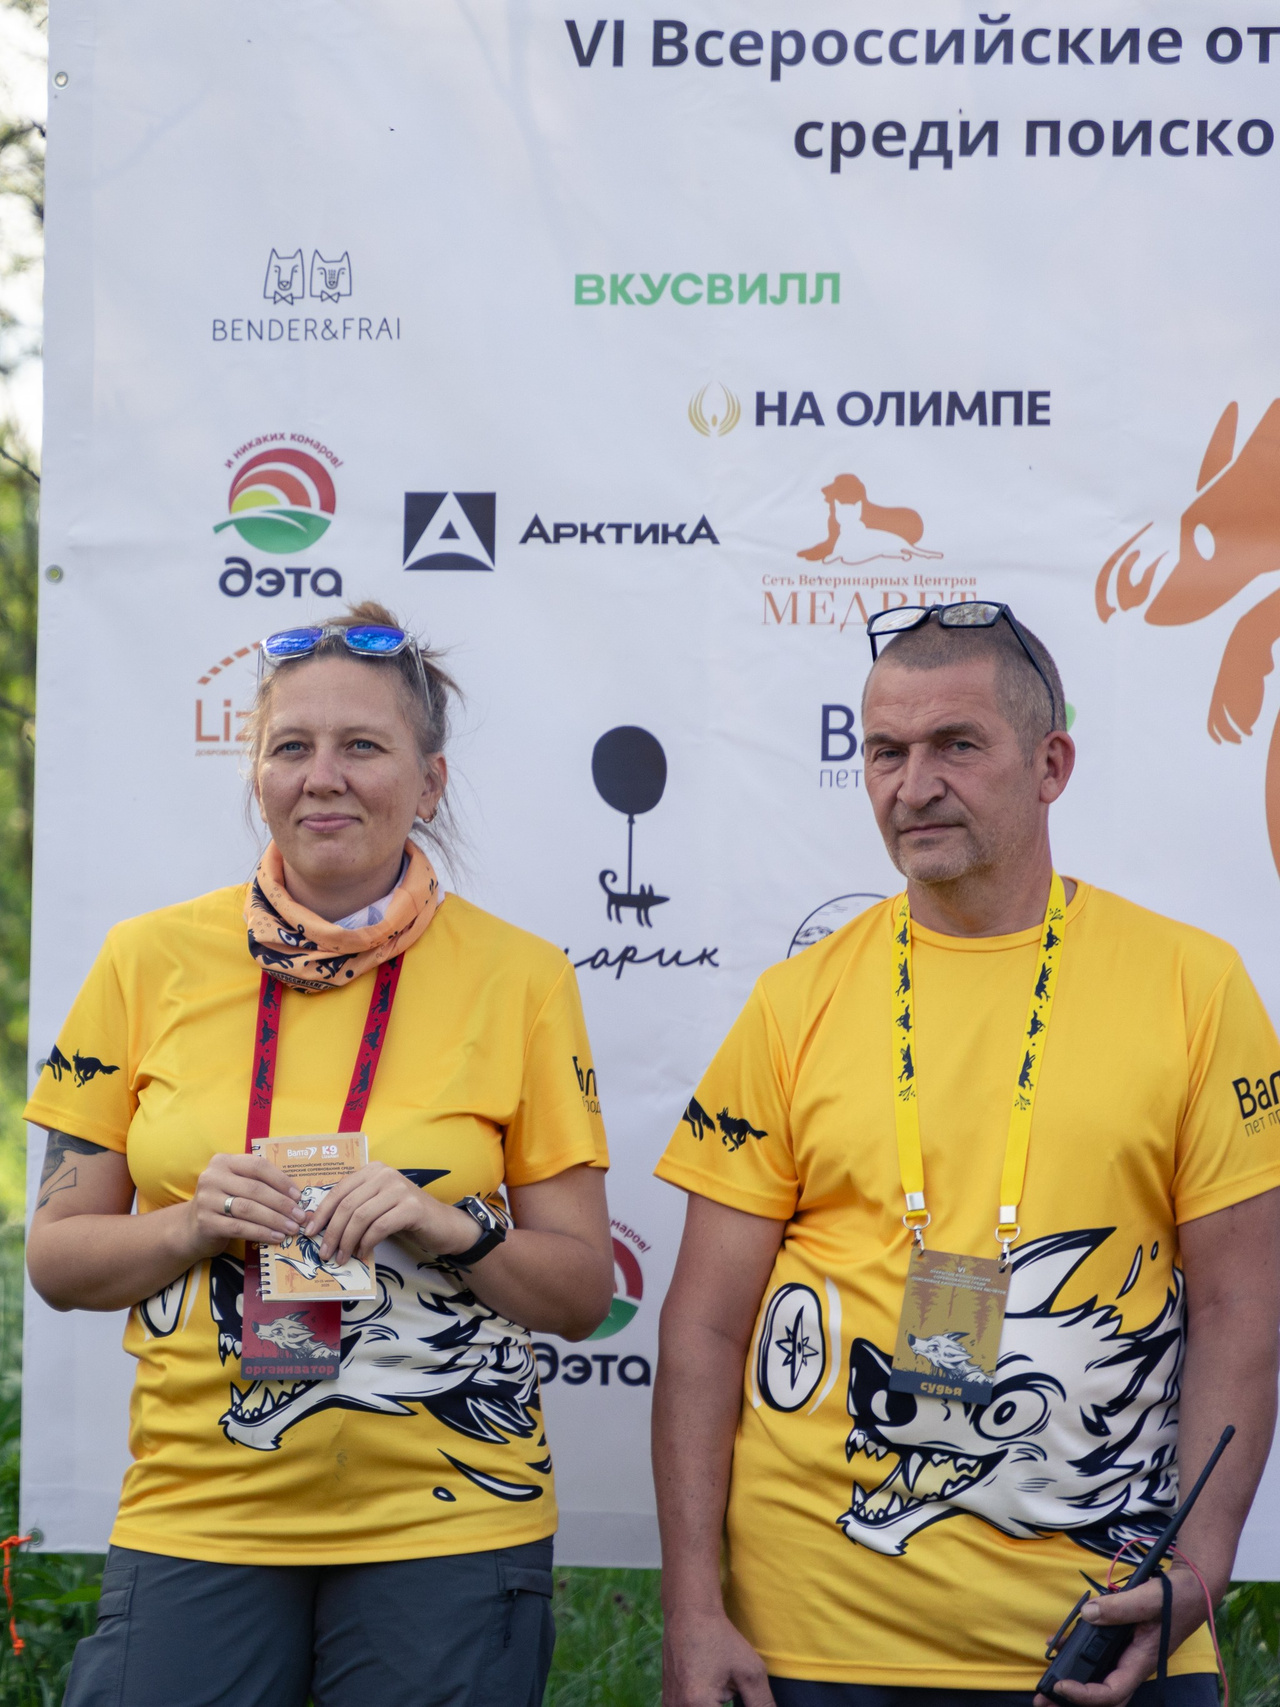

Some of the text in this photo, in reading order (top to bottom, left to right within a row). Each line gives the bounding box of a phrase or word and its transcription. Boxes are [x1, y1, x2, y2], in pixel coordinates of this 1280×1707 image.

[565, 19, 624, 68] VI
[651, 13, 1184, 82] Всероссийские
[793, 116, 1276, 174] среди поиско
[574, 272, 841, 306] ВКУСВИЛЛ
[211, 317, 401, 342] BENDER&FRAI
[755, 390, 1051, 427] НА ОЛИМПЕ
[224, 432, 344, 469] и никаких комаров!
[761, 574, 977, 589] Сеть Ветеринарных Центров
[1244, 1116, 1266, 1138] пет
[245, 1365, 335, 1376] организатор
[920, 1381, 963, 1397] судья
